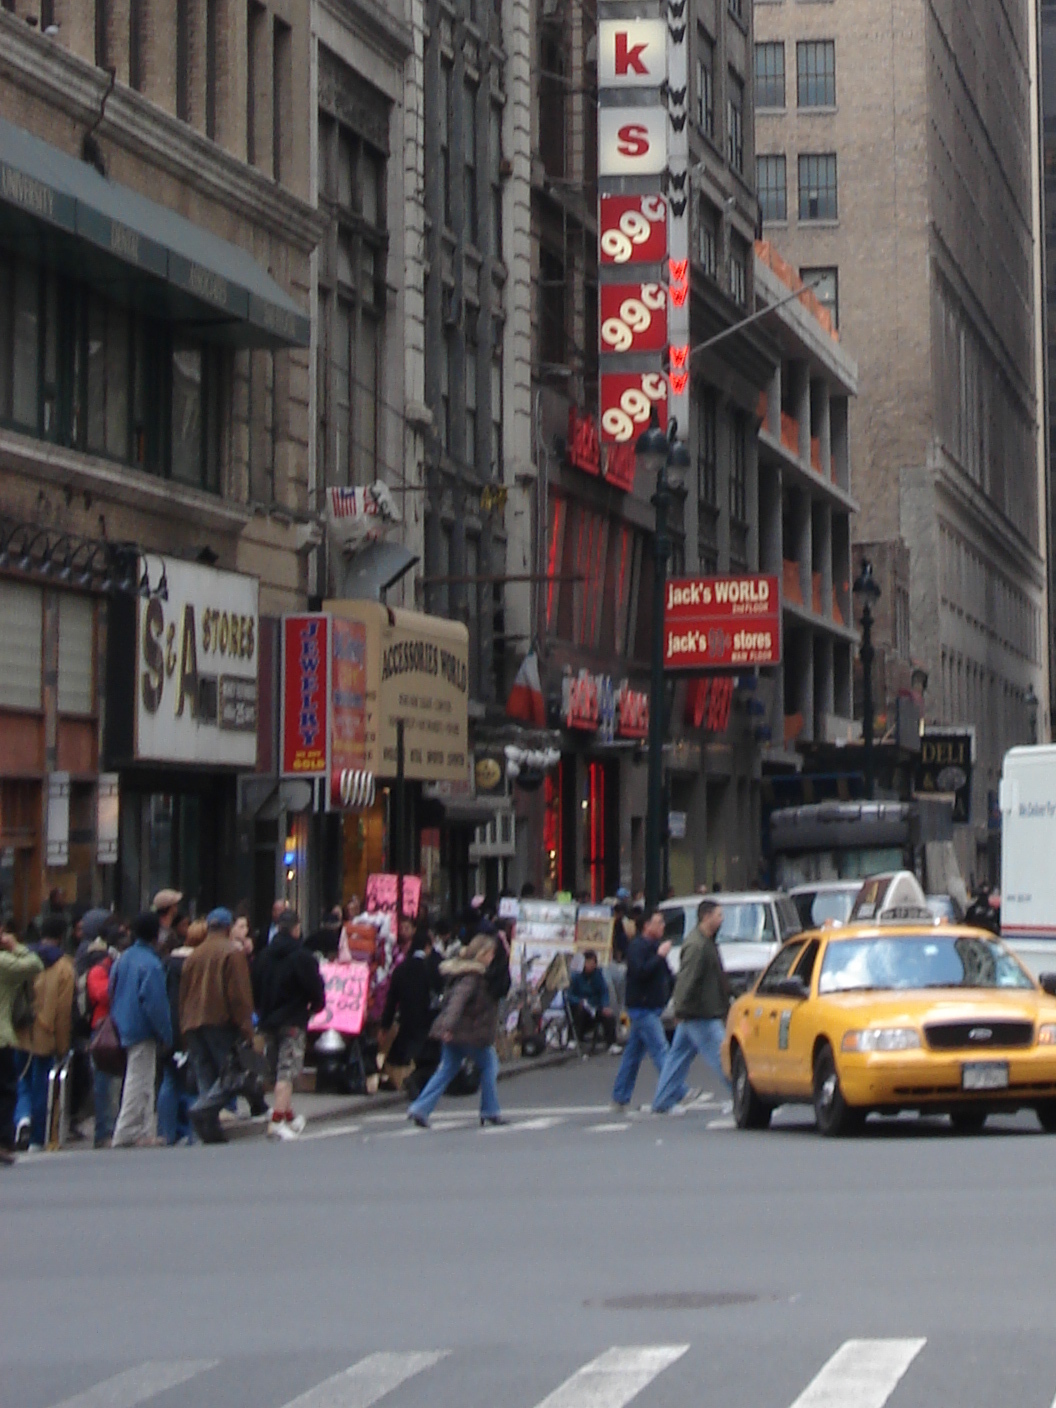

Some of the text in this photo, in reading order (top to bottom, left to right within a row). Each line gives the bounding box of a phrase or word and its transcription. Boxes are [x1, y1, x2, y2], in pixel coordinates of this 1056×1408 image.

[667, 580, 769, 610] jack's WORLD
[202, 606, 254, 659] STORES
[667, 630, 707, 658] jack's
[733, 629, 772, 650] stores
[382, 639, 439, 683] ACCESSORIES
[299, 619, 320, 747] JEWELRY
[293, 758, 325, 770] GOLD
[922, 742, 966, 763] DELI
